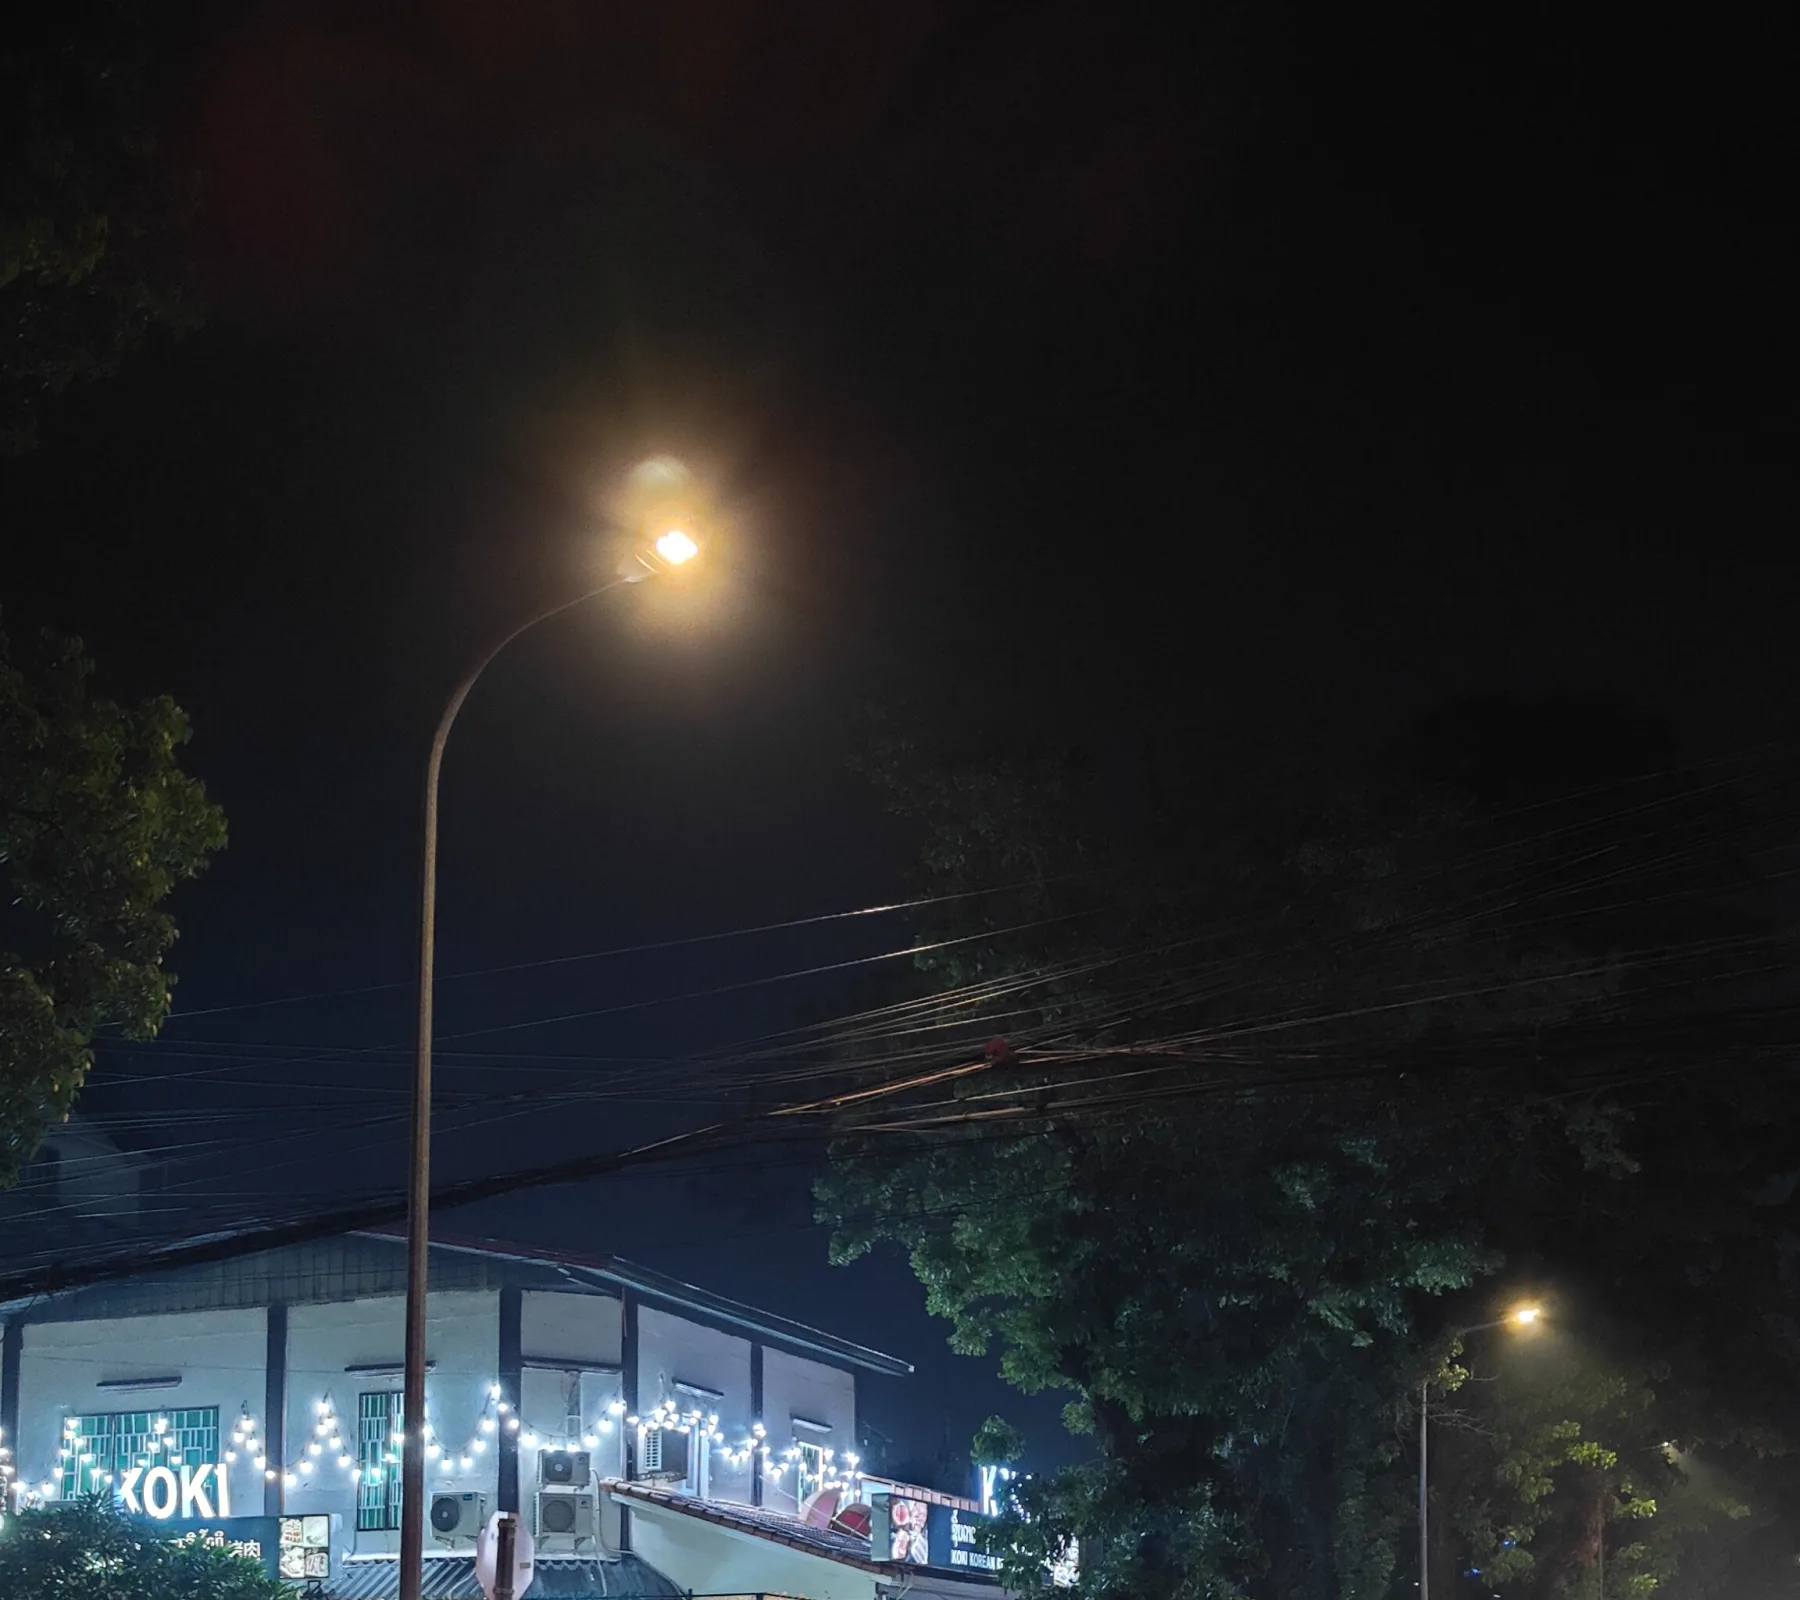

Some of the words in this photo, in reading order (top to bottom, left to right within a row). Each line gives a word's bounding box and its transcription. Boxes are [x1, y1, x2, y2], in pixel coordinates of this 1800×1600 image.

[119, 1463, 231, 1519] KOKI
[951, 1549, 968, 1566] KOKI
[969, 1552, 996, 1571] KOREAN
